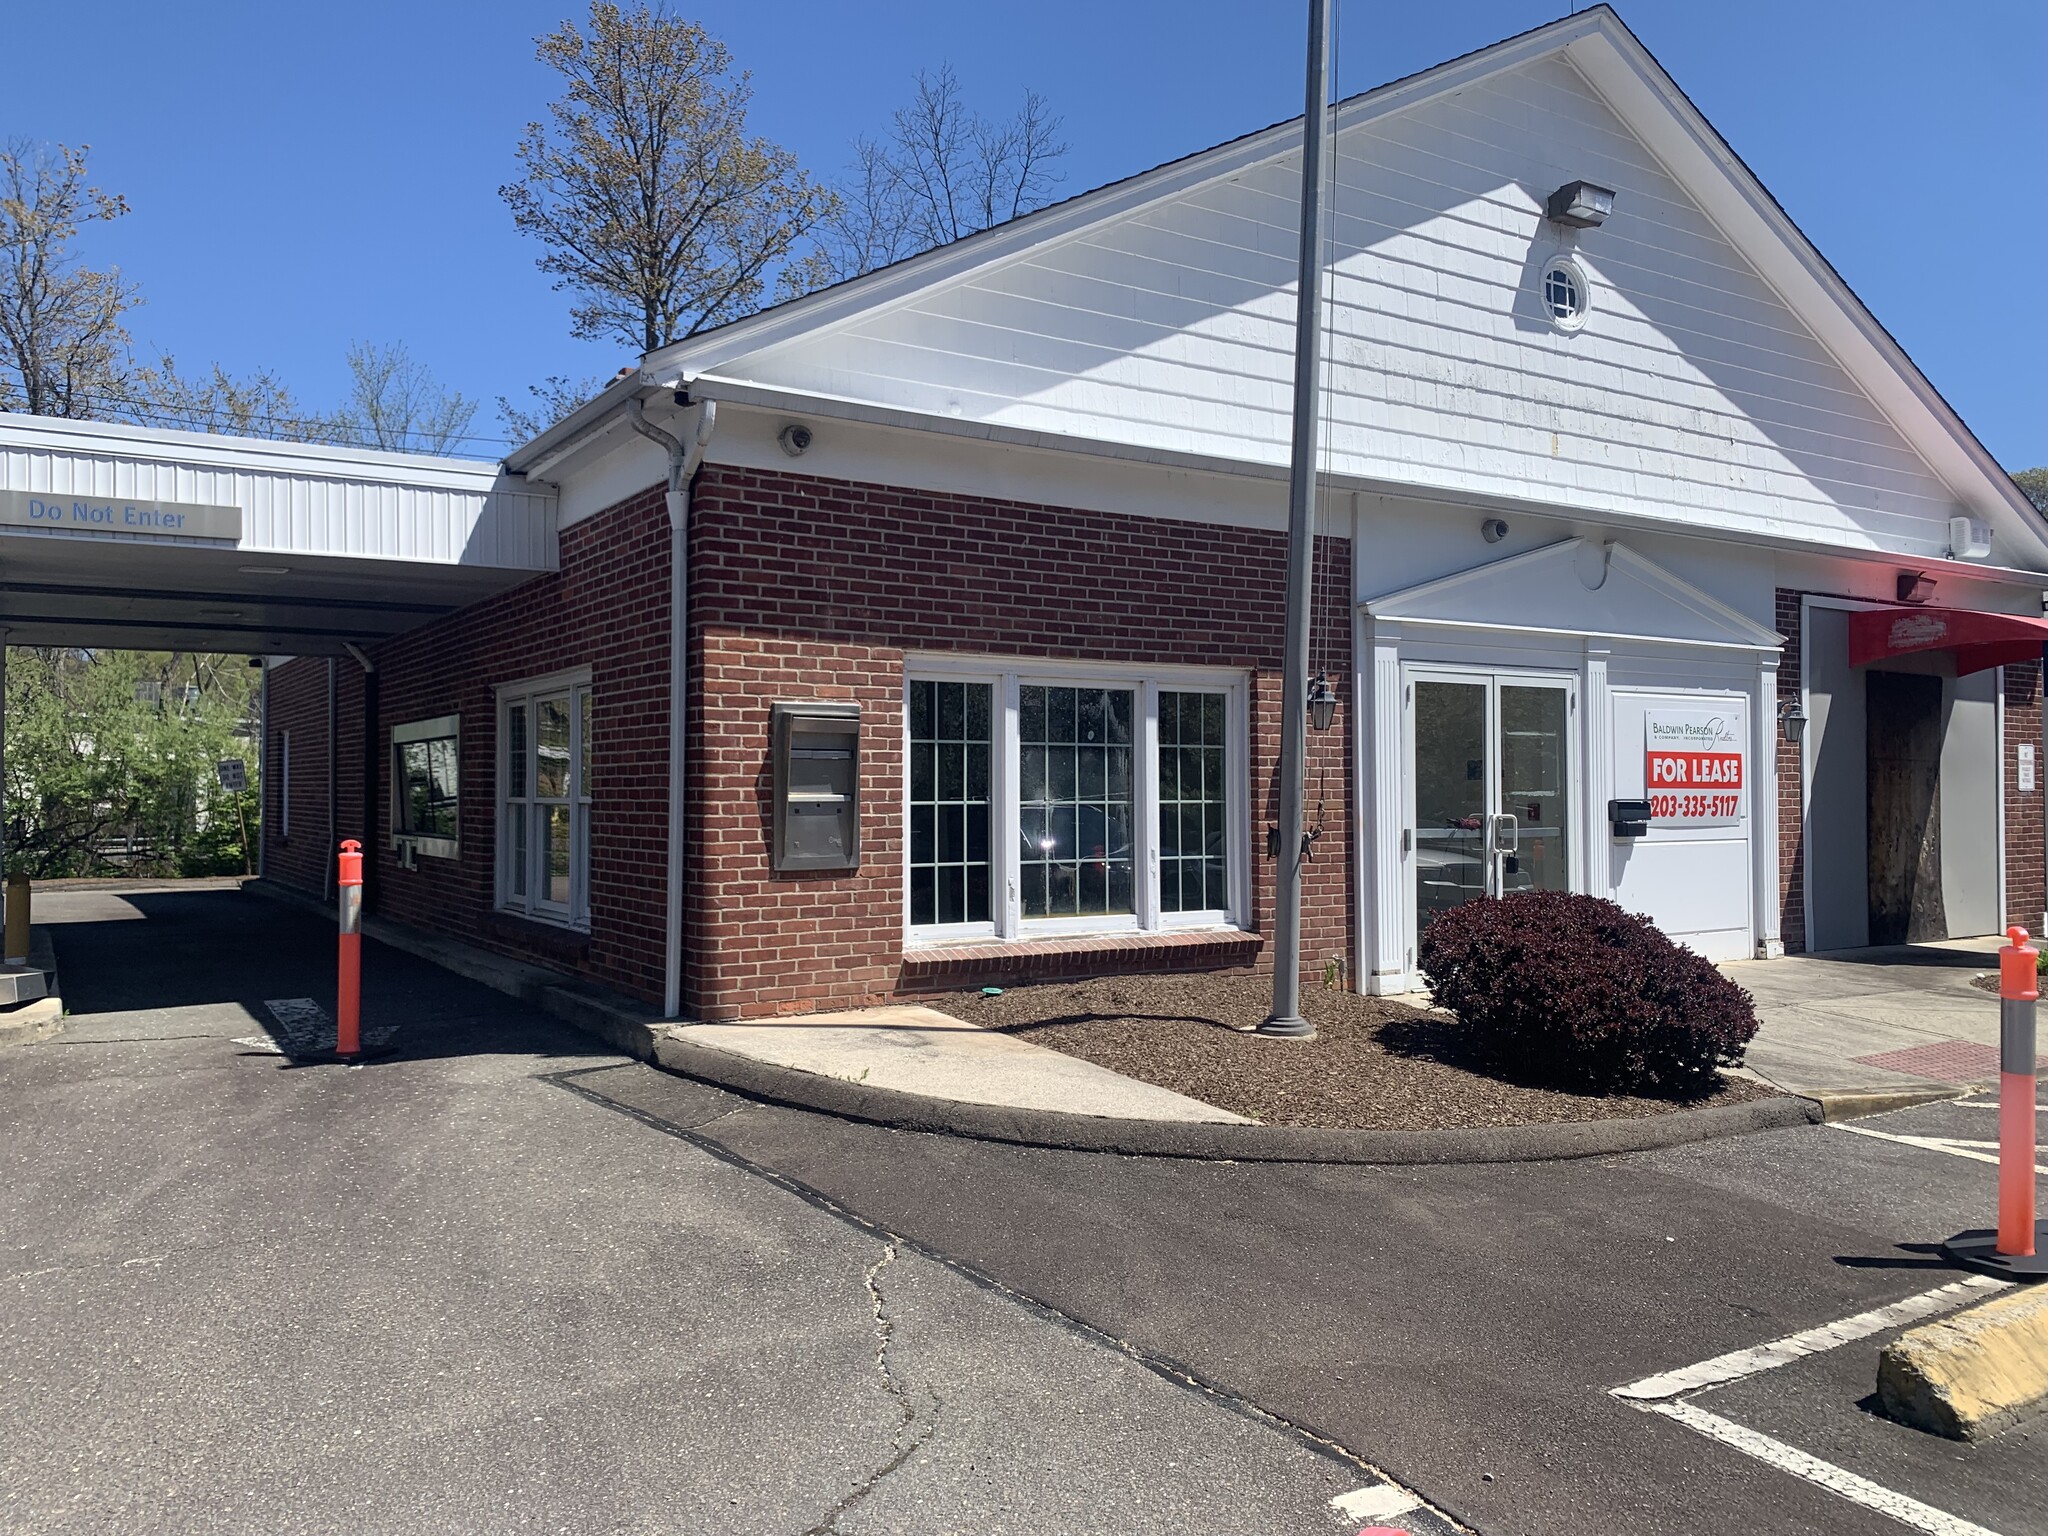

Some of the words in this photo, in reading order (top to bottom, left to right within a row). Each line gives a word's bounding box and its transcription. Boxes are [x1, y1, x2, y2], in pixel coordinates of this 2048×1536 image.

[28, 499, 62, 520] Do
[73, 502, 114, 524] Not
[124, 506, 186, 529] Enter
[1653, 722, 1684, 734] BALDWIN
[1685, 723, 1713, 736] PEARSON
[1653, 758, 1687, 782] FOR
[1692, 759, 1738, 783] LEASE
[1651, 795, 1738, 817] 203-335-5117
